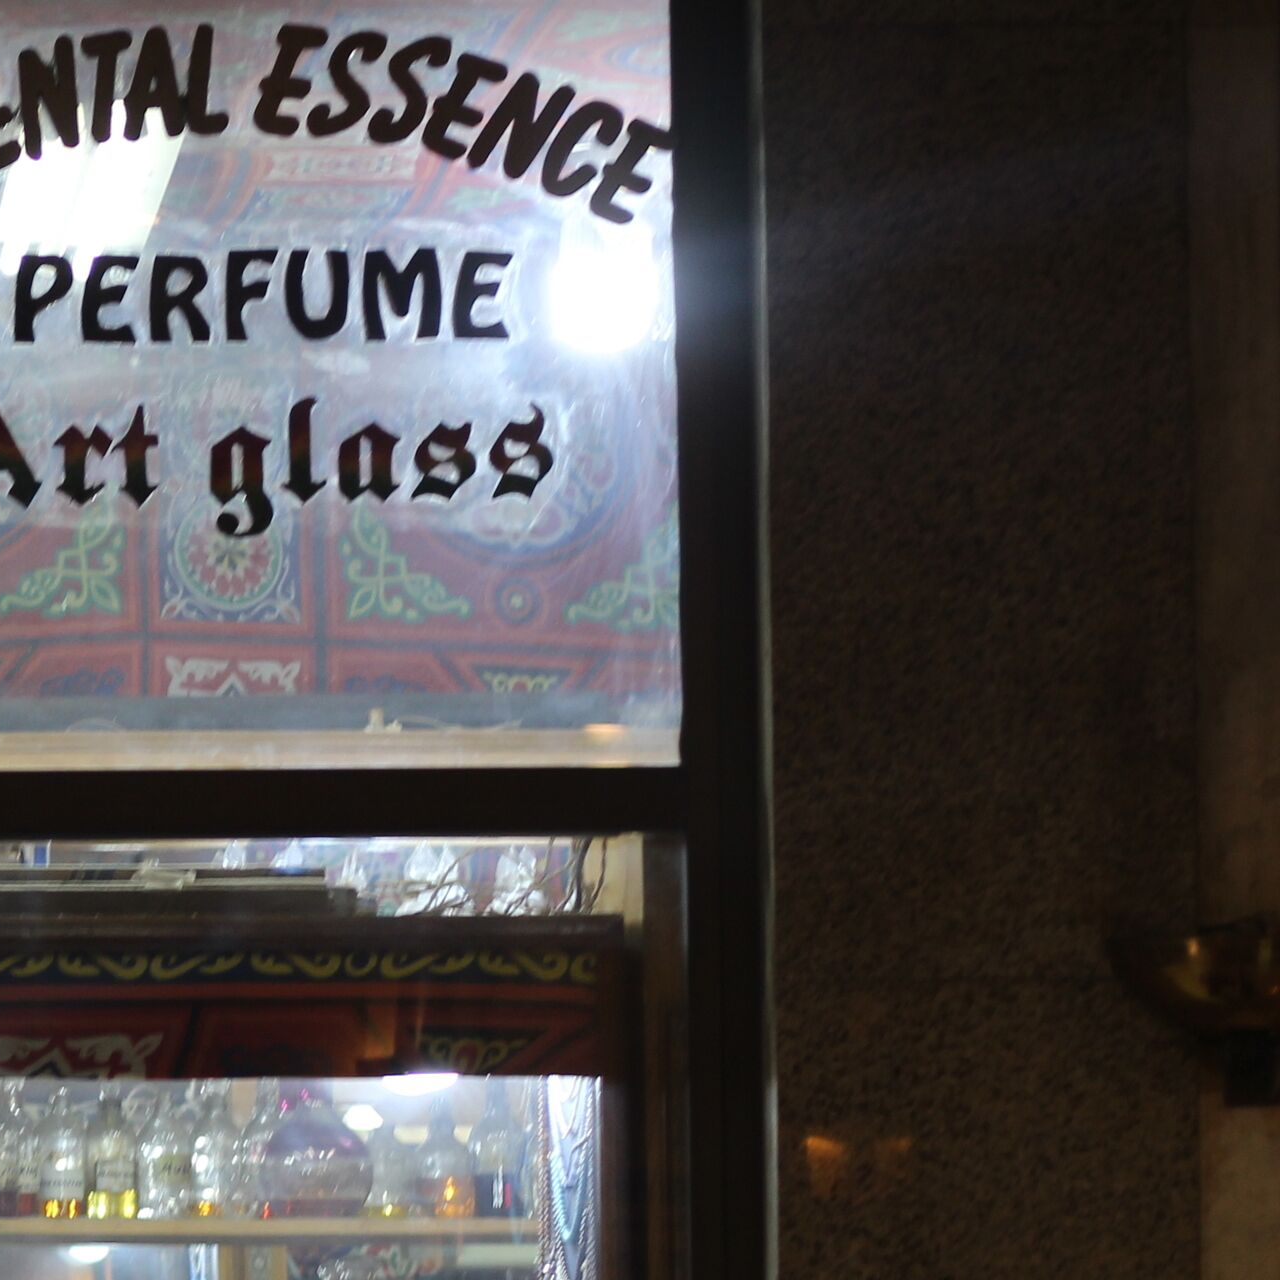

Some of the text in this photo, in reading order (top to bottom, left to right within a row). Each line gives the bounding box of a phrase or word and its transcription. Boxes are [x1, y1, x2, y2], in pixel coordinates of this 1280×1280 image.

[252, 24, 674, 226] ESSENCE
[14, 247, 514, 343] PERFUME
[209, 393, 556, 539] glass
